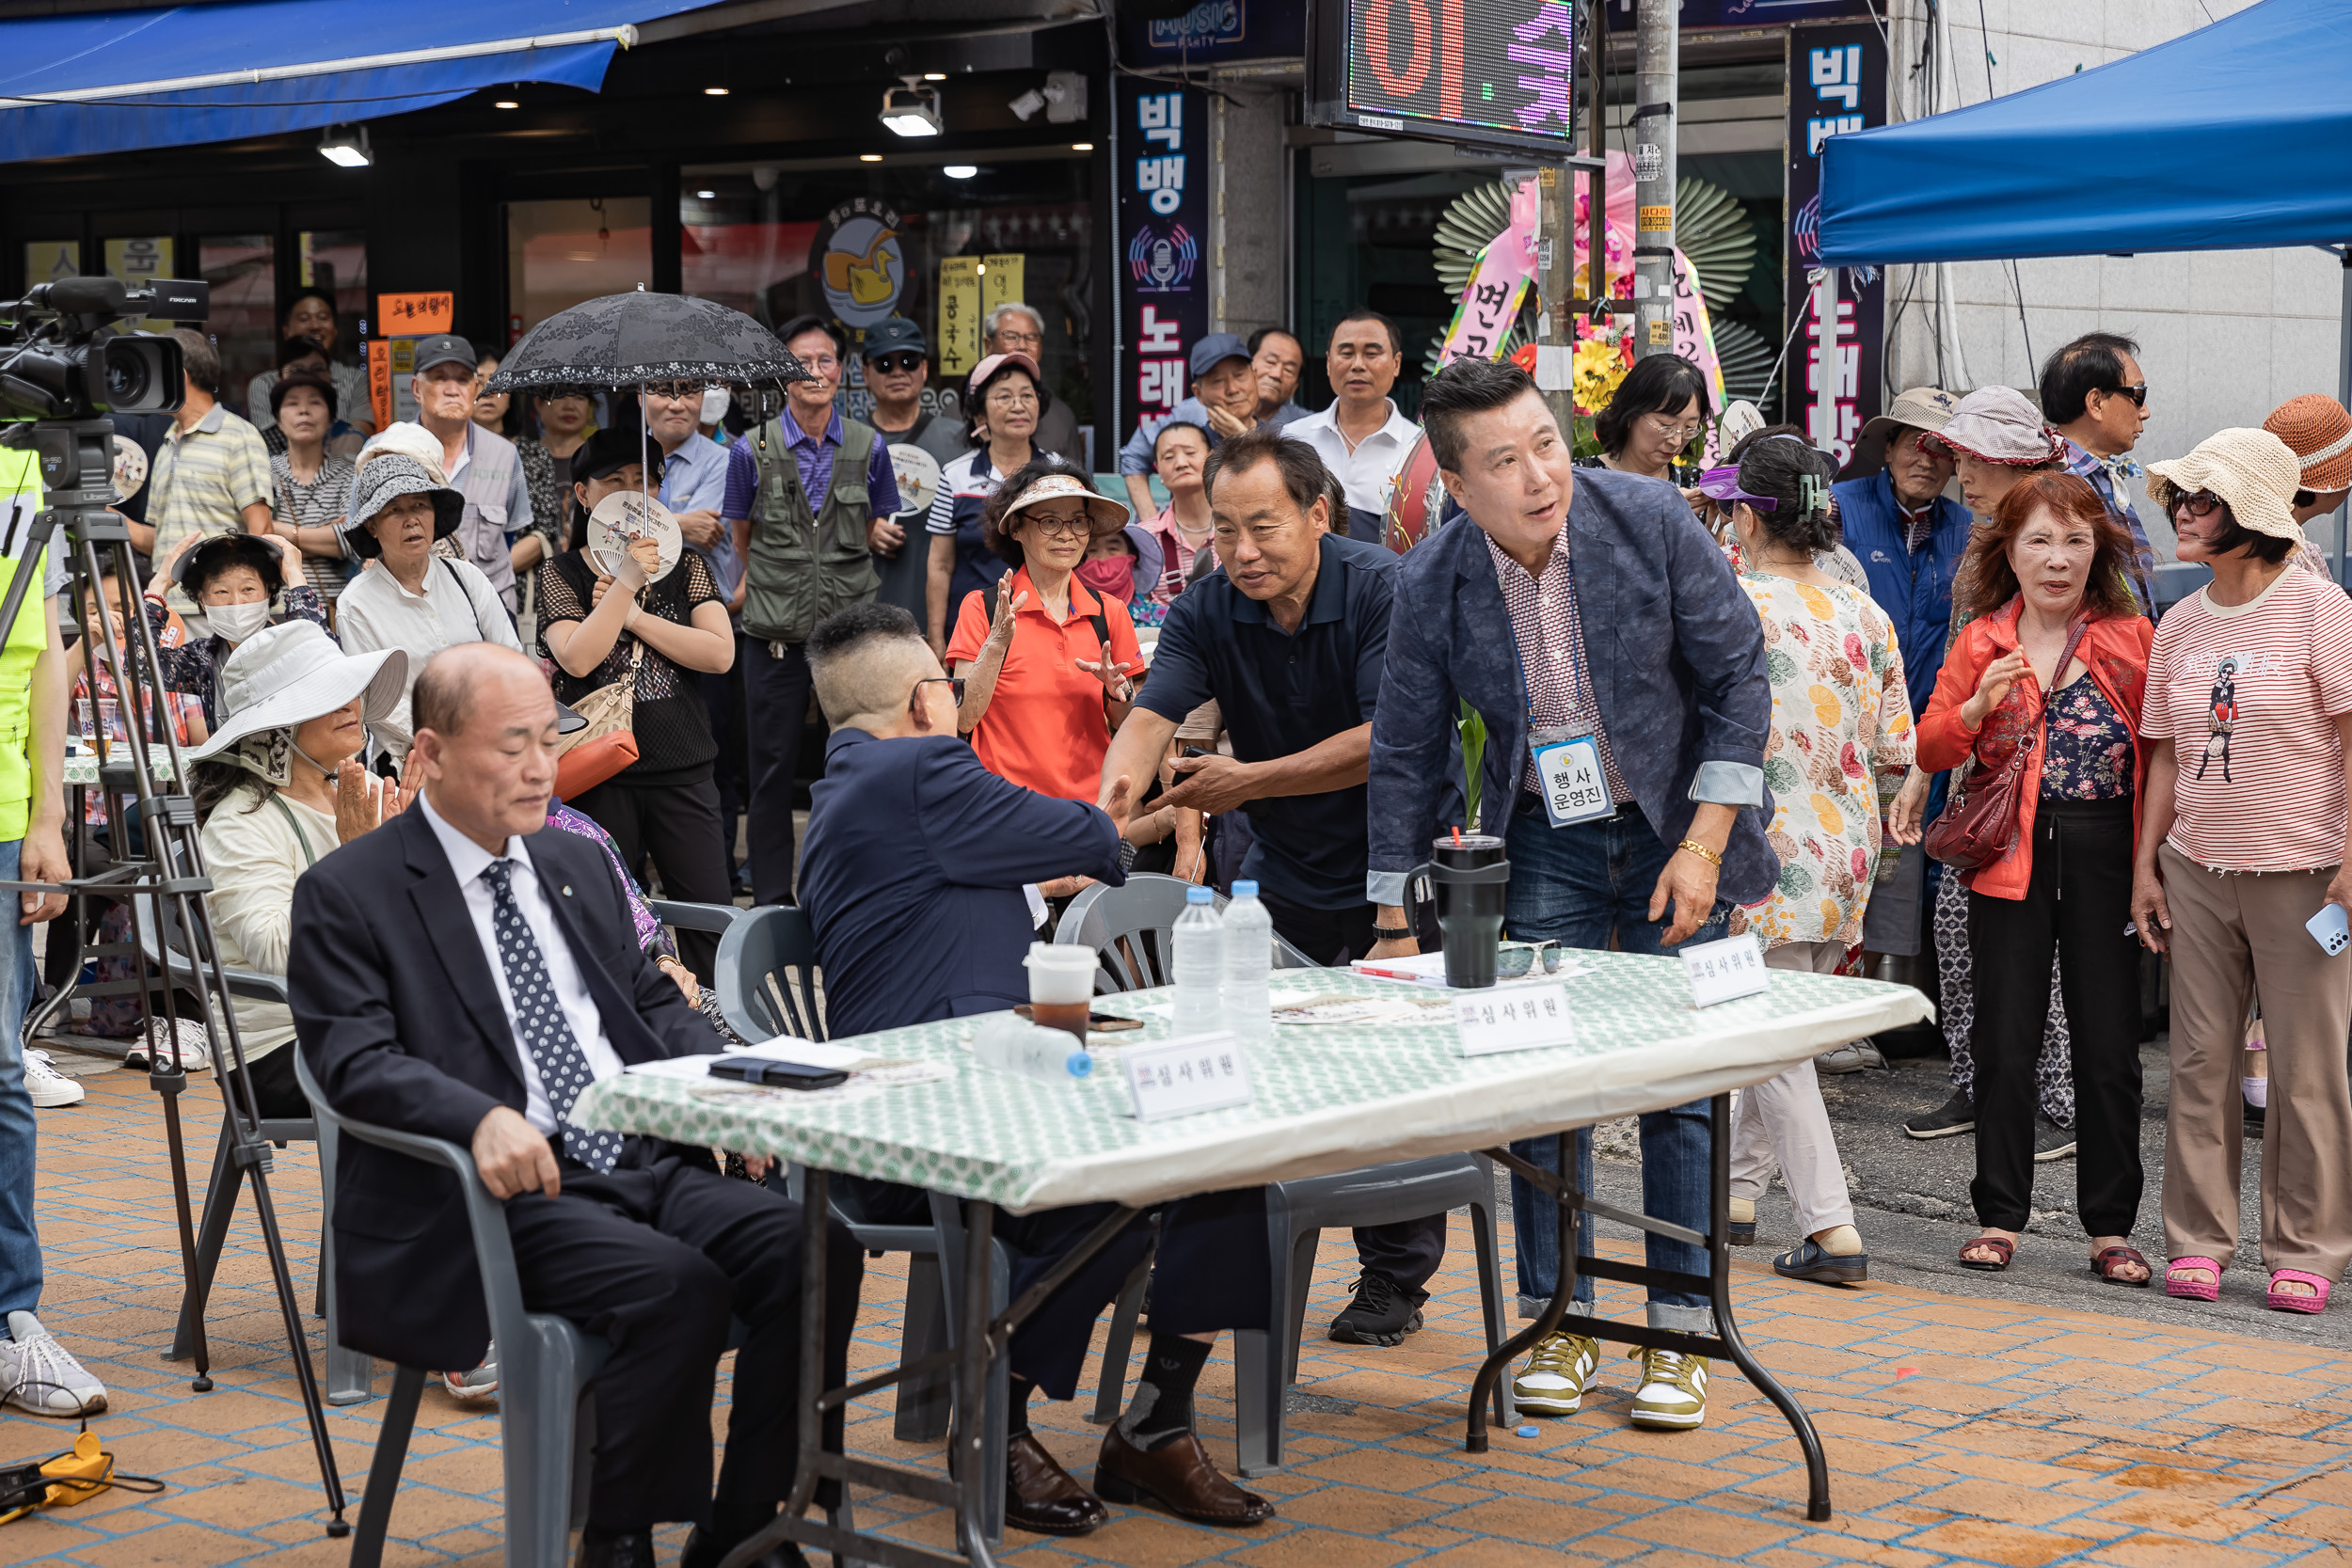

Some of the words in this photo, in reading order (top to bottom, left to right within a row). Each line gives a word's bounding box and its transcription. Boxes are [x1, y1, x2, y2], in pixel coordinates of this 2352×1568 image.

[1136, 92, 1186, 215] 빅뱅
[1136, 304, 1186, 432] 노래
[1554, 786, 1602, 811] 운영진
[1705, 949, 1756, 978] 심사위원
[1482, 997, 1558, 1024] 심사위원
